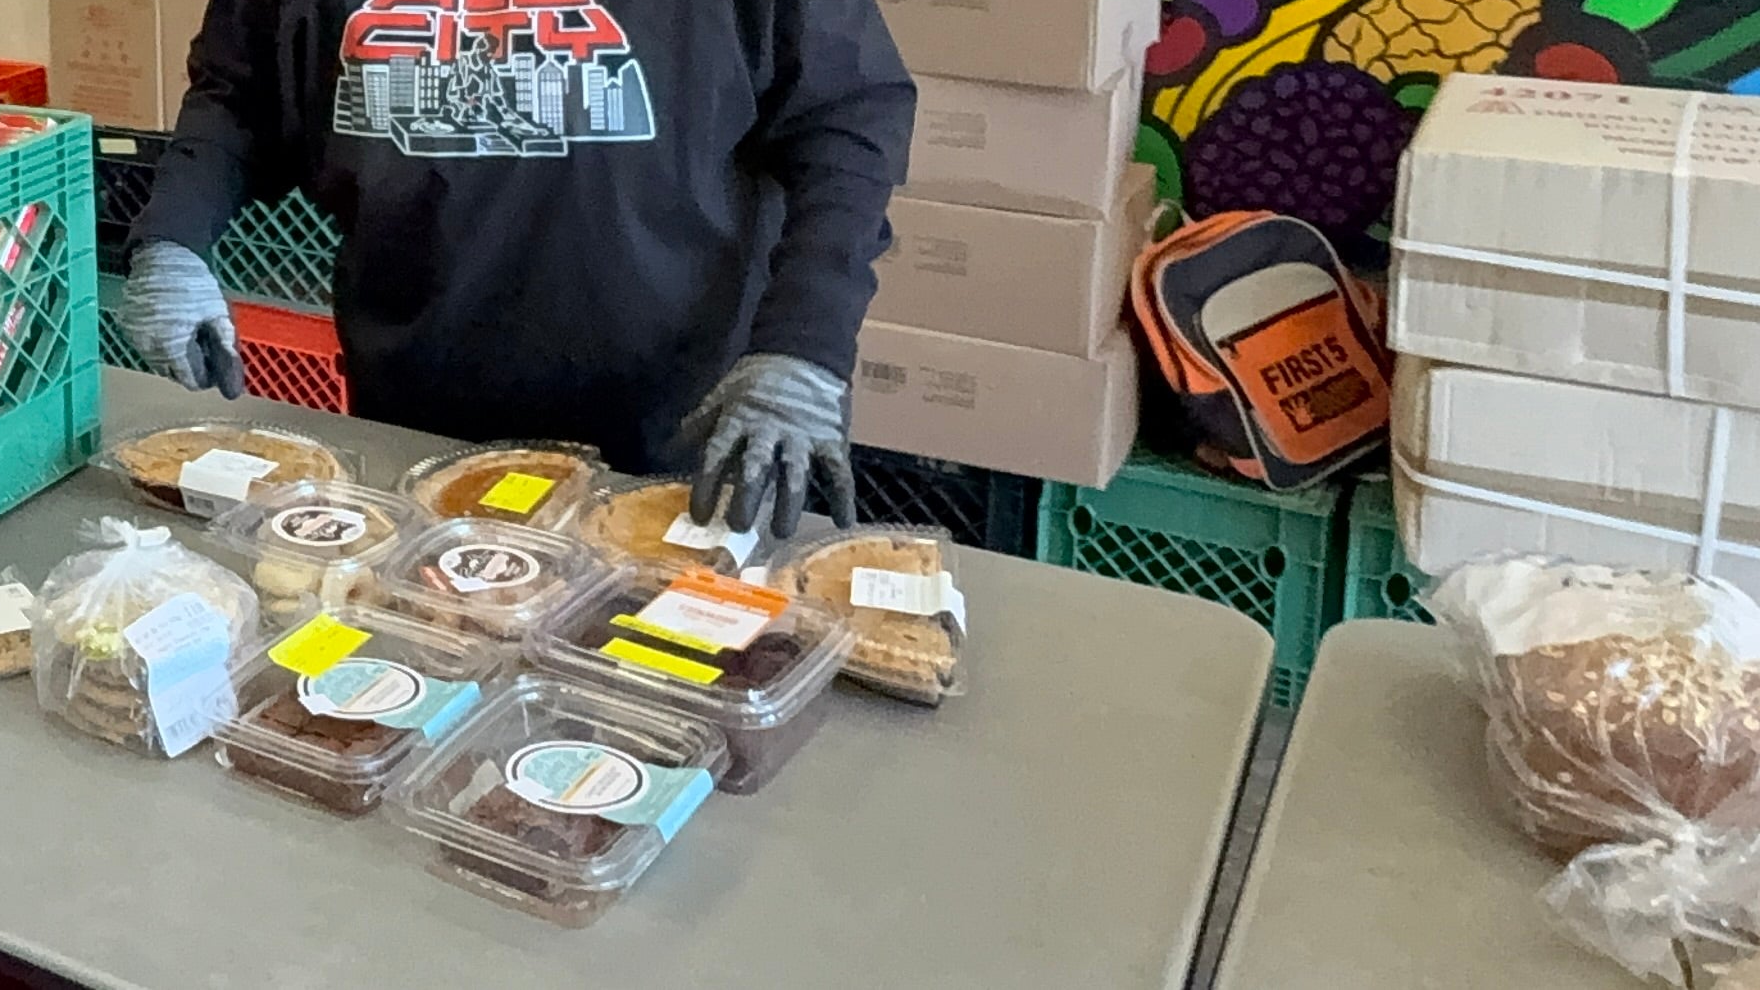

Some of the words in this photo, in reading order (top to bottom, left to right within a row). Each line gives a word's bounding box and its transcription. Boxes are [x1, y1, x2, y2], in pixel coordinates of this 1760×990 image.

[340, 9, 632, 66] CITY
[1259, 342, 1335, 396] FIRST
[1323, 332, 1349, 363] 5
